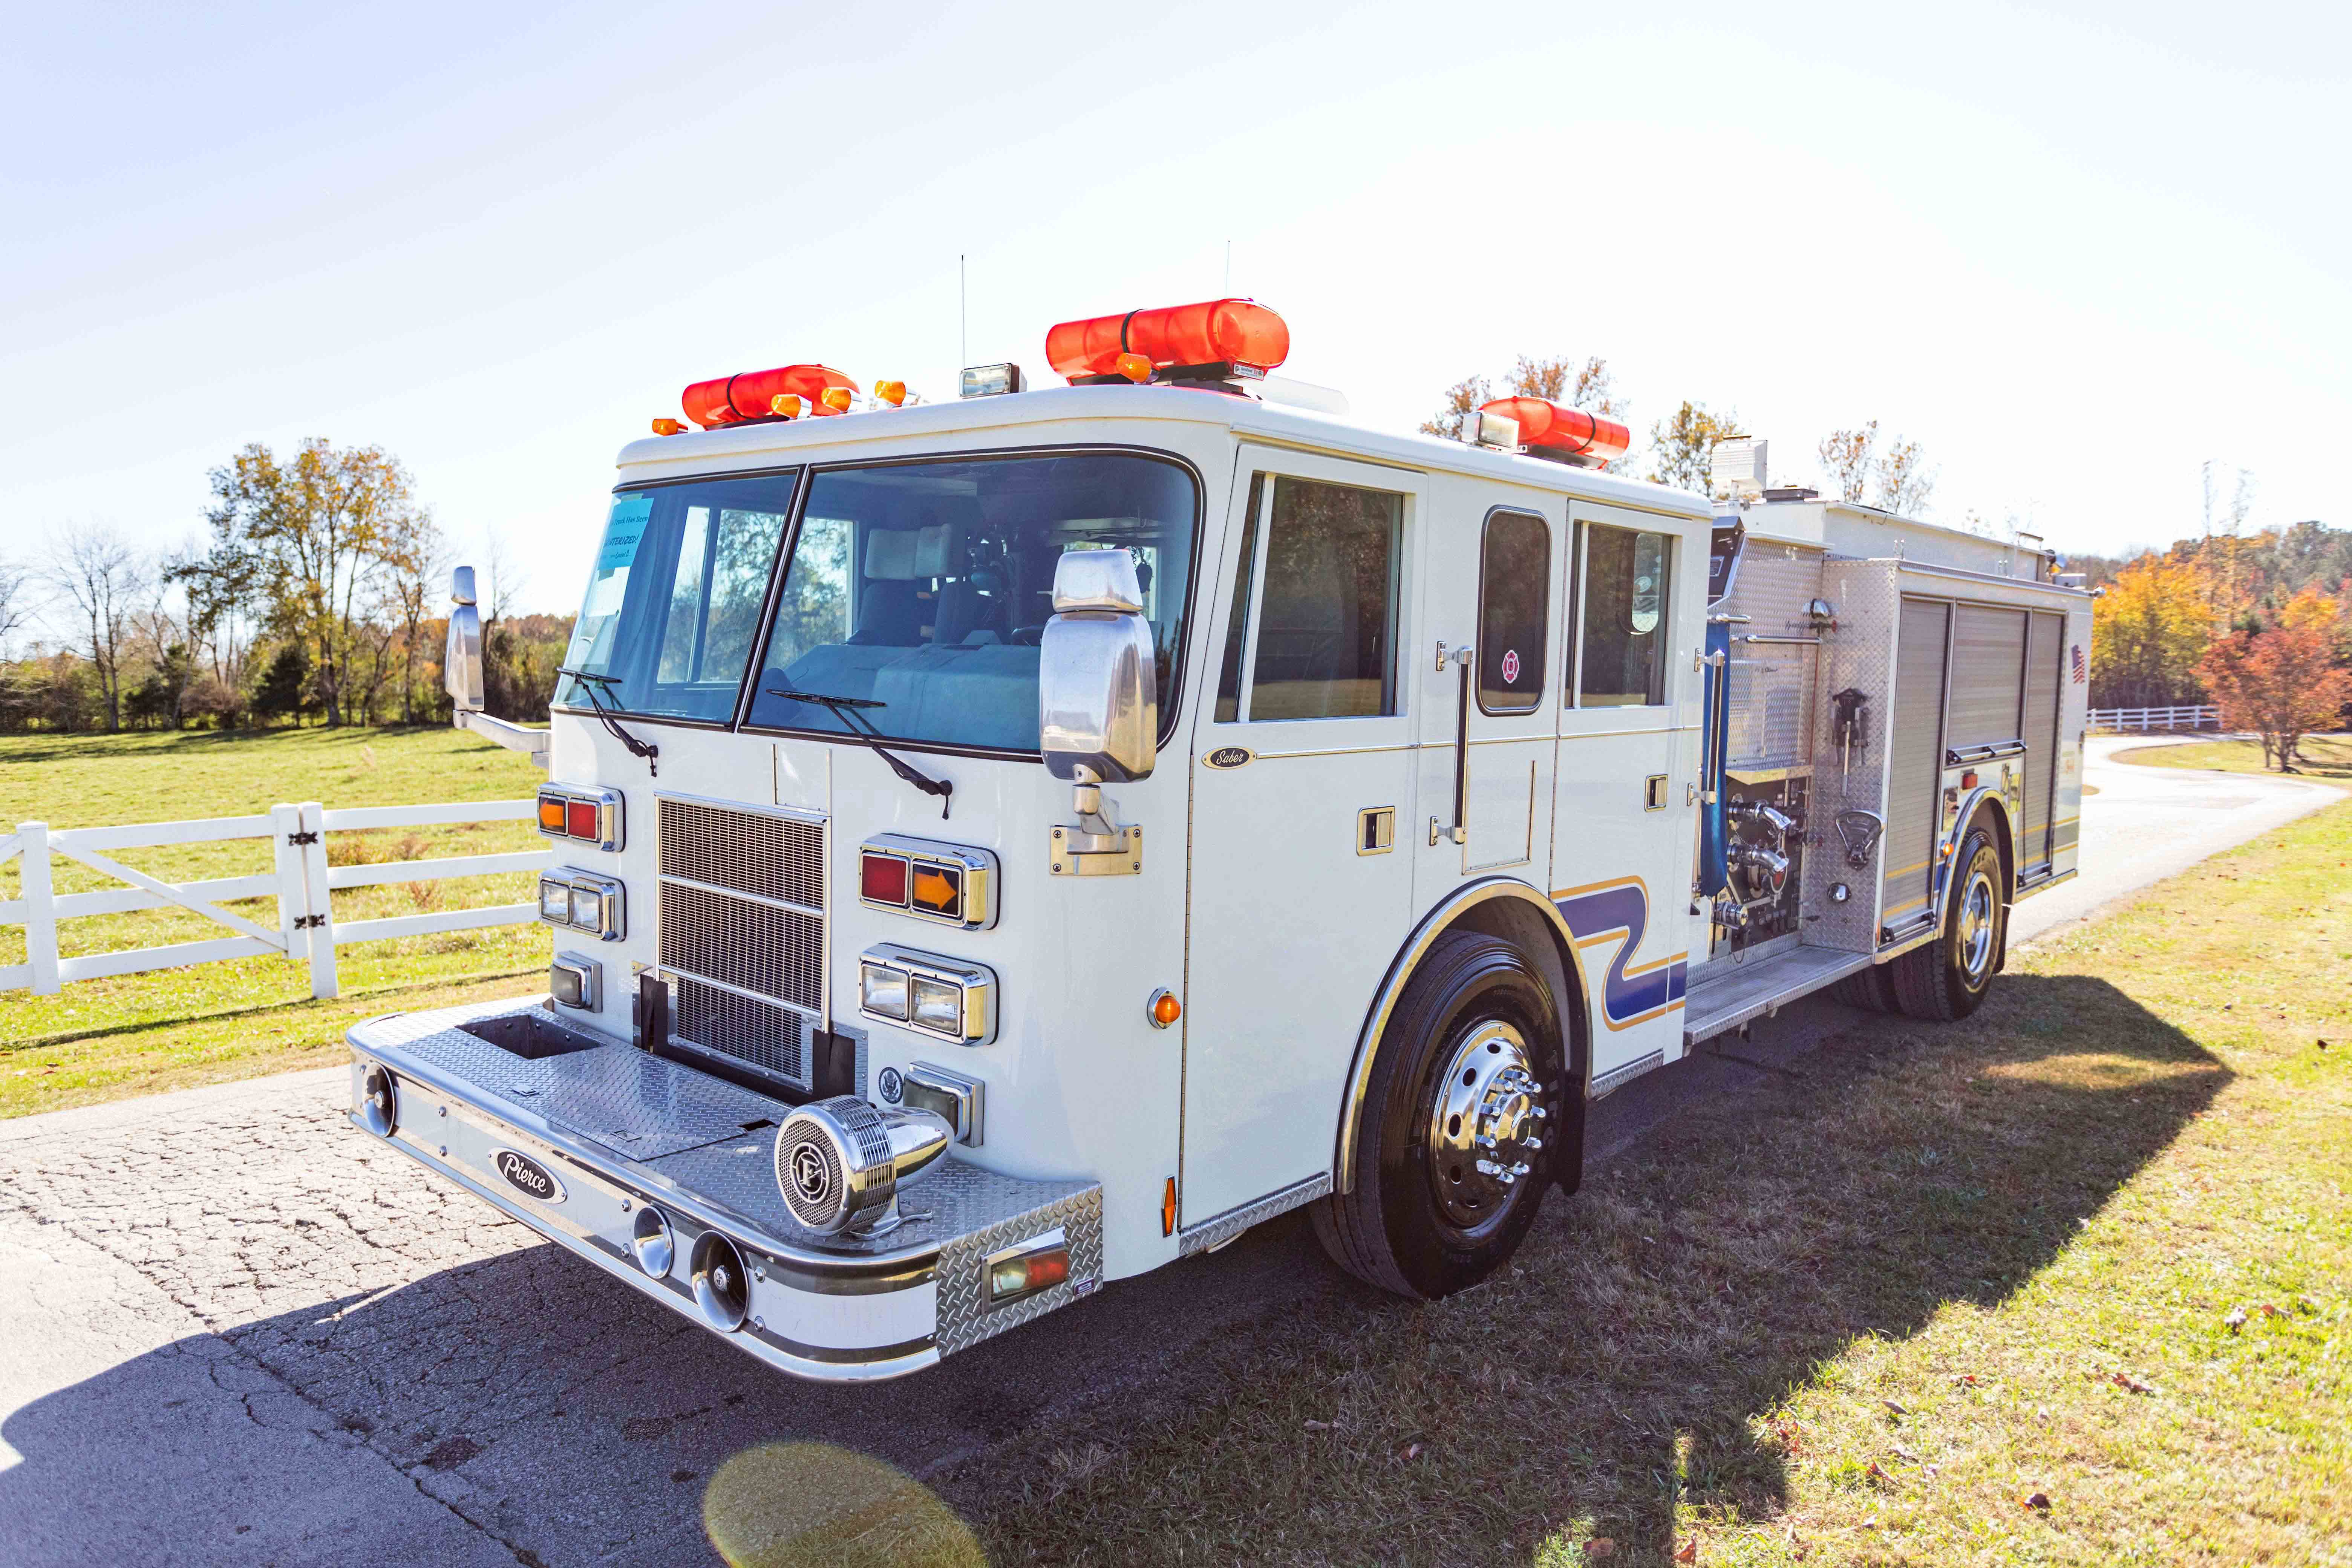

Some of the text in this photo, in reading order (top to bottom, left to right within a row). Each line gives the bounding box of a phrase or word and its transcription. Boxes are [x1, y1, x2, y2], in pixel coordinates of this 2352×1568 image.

[604, 533, 640, 546] TERIZED!
[1216, 750, 1243, 764] Saber
[504, 1153, 547, 1193] Pierce
